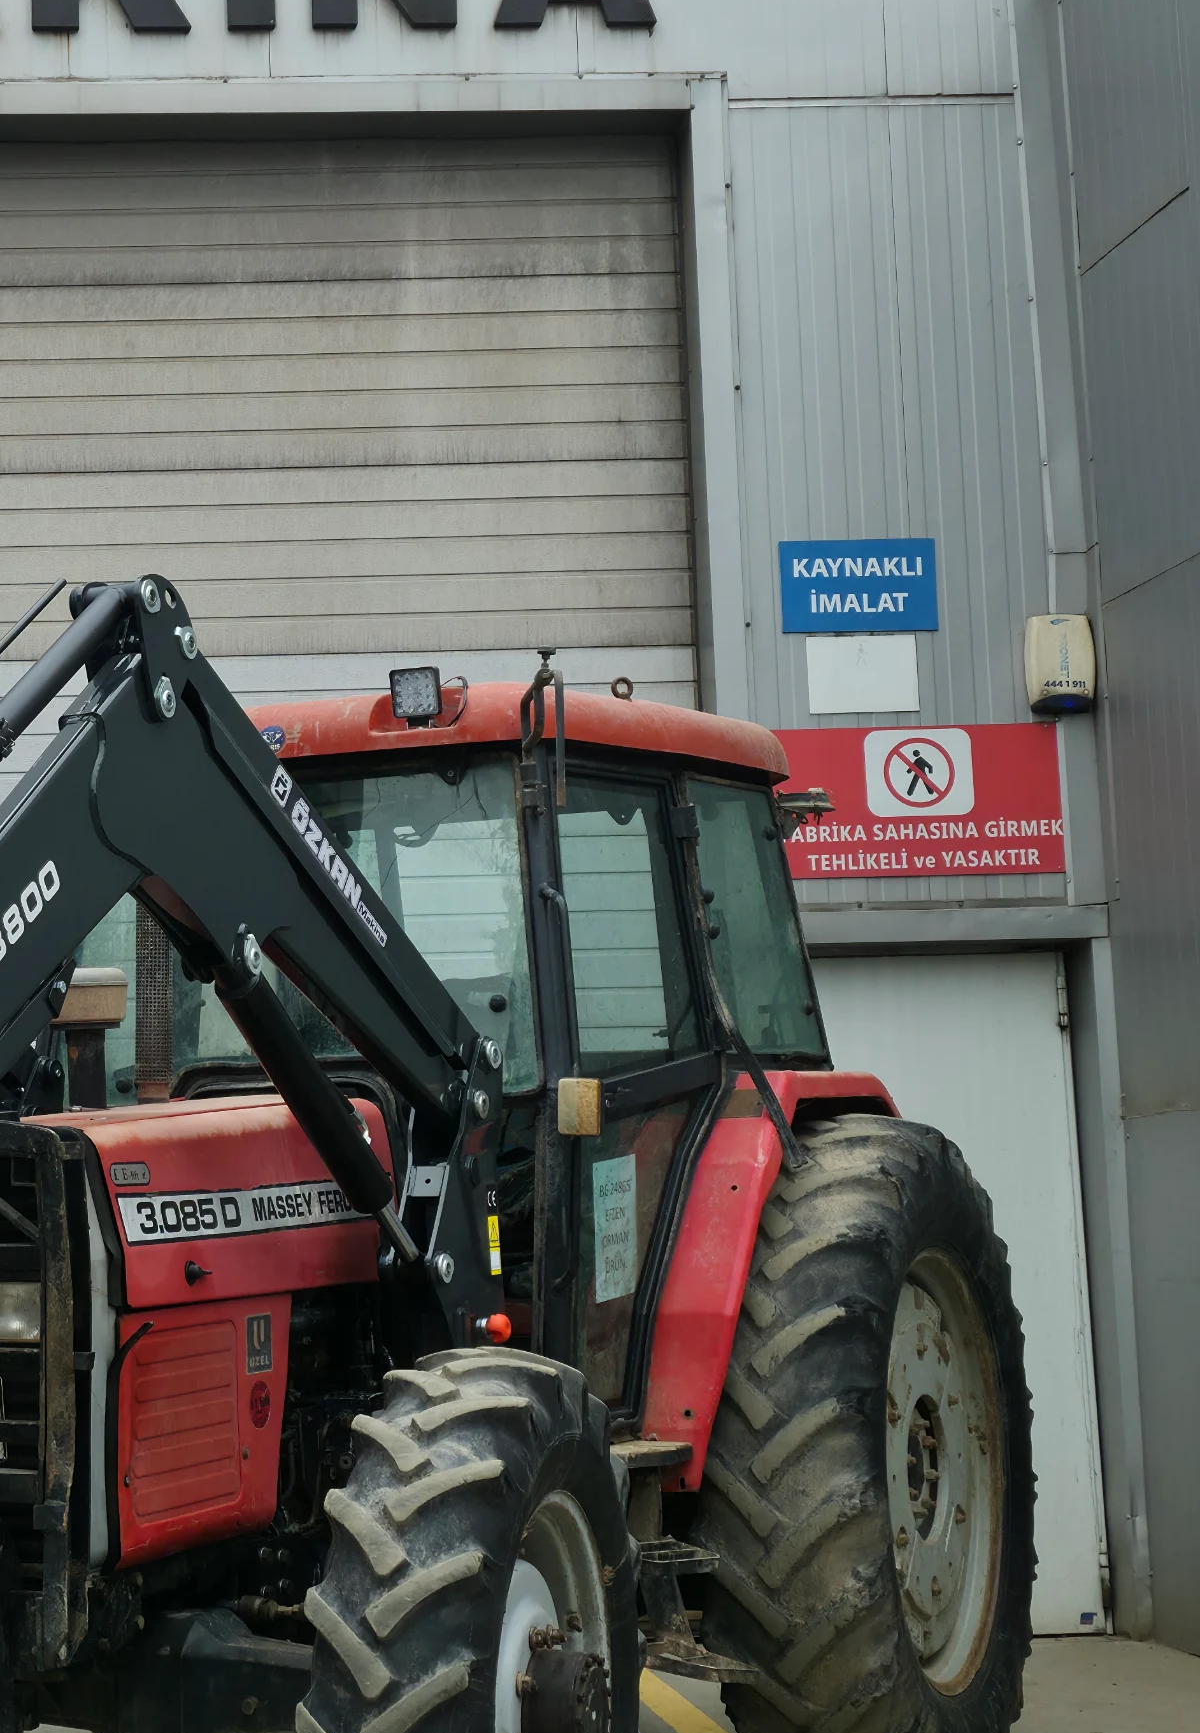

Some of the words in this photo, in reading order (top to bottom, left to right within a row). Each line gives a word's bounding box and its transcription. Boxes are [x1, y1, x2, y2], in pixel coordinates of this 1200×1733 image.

[793, 556, 923, 578] KAYNAKLI
[810, 588, 909, 613] İMALAT
[1044, 680, 1063, 688] 444
[1072, 680, 1086, 688] 911
[783, 821, 867, 843] ABRİKA
[873, 821, 979, 841] SAHASINA
[984, 816, 1064, 838] GİRMEK
[291, 797, 363, 910] ÖZKAN
[807, 848, 909, 871] TEHLİKELİ
[914, 855, 936, 868] ve
[941, 848, 1041, 868] YASAKTIR
[357, 902, 387, 947] Makina
[136, 1197, 219, 1235] 3.085
[220, 1196, 241, 1228] D
[251, 1192, 313, 1222] MASSEY
